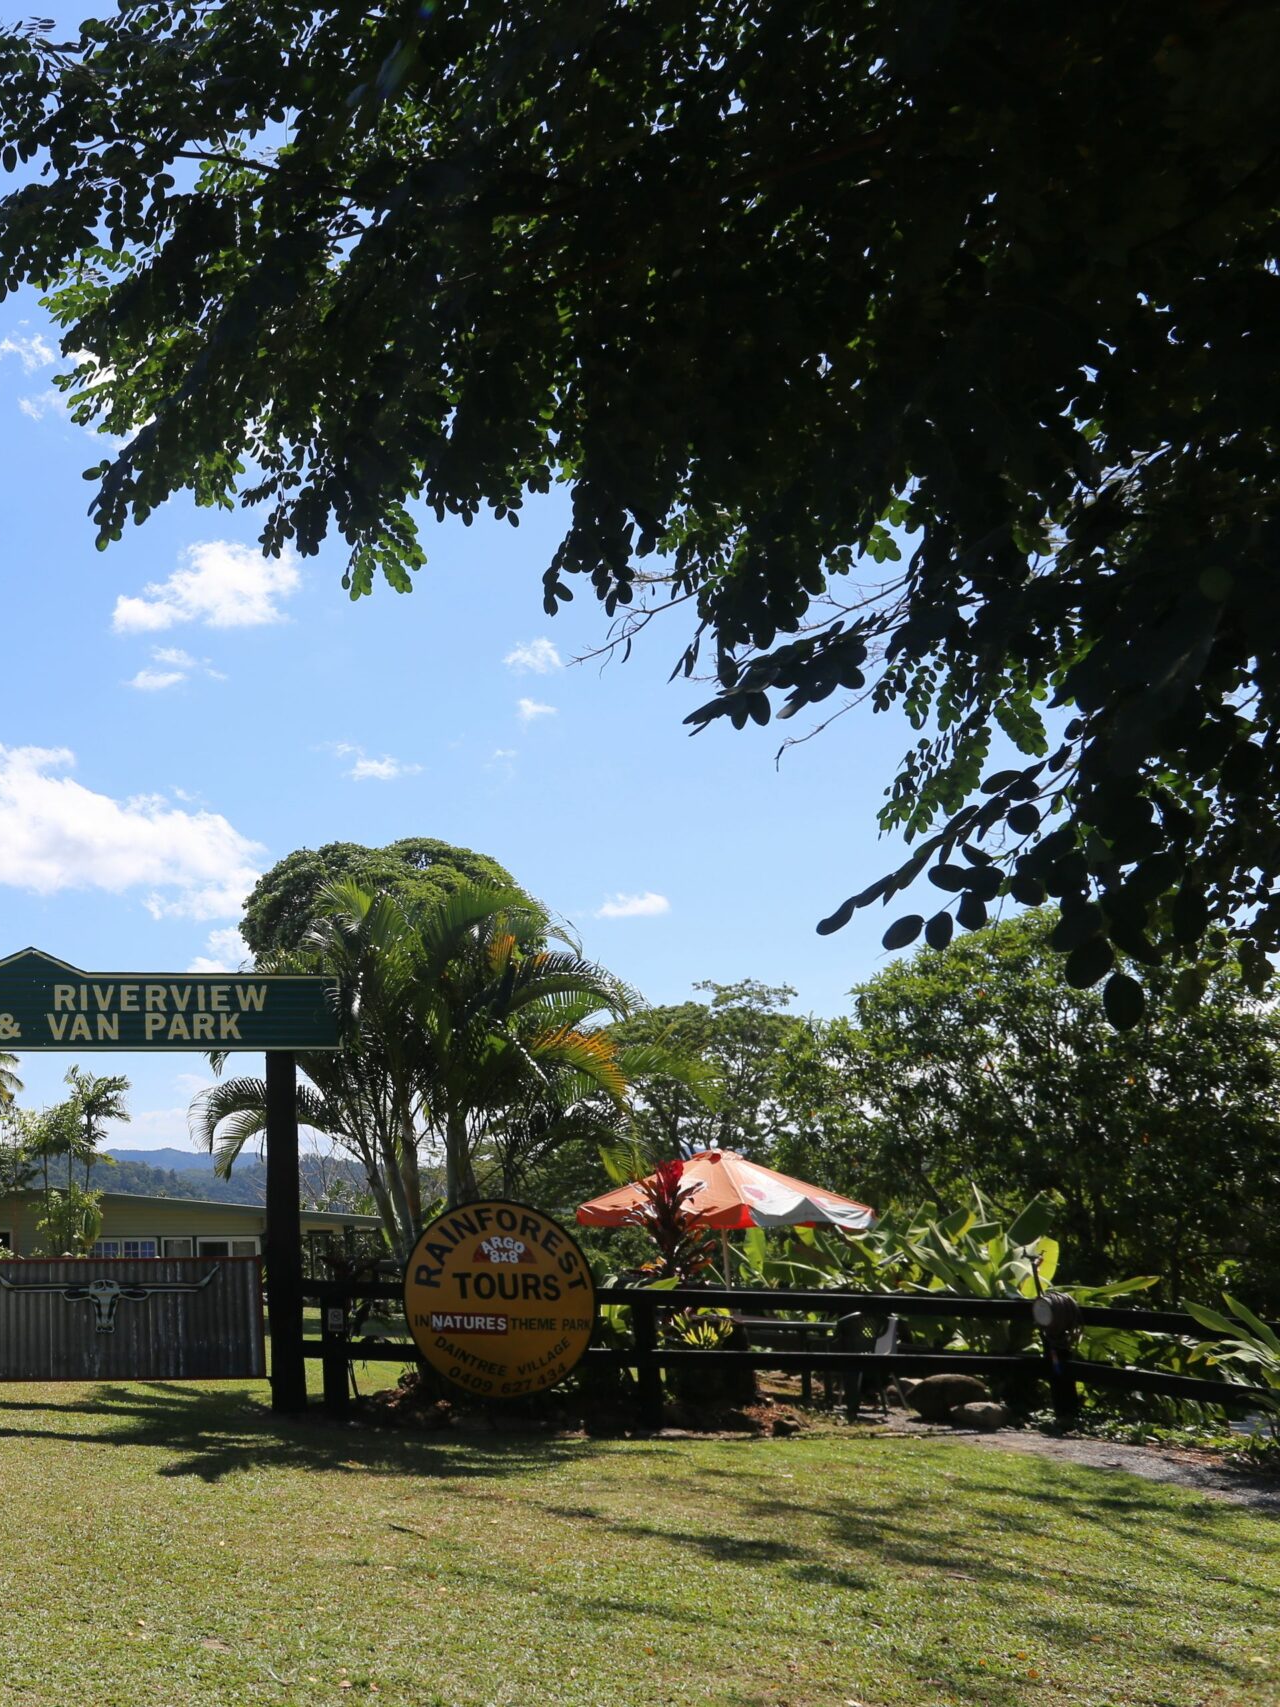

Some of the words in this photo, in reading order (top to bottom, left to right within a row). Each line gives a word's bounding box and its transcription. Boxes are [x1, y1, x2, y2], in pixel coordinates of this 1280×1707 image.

[53, 984, 268, 1012] RIVERVIEW
[46, 1013, 120, 1041] VAN
[144, 1013, 243, 1040] PARK
[414, 1208, 588, 1290] RAINFOREST
[480, 1236, 526, 1255] ARGO
[452, 1271, 561, 1302] TOURS
[414, 1314, 431, 1327] IN
[431, 1314, 507, 1331] NATURES
[511, 1318, 557, 1331] THEME
[562, 1318, 591, 1332] PARK
[435, 1336, 508, 1377] DAINTREE
[515, 1336, 570, 1376] VILLAGE
[448, 1365, 493, 1393] 0409
